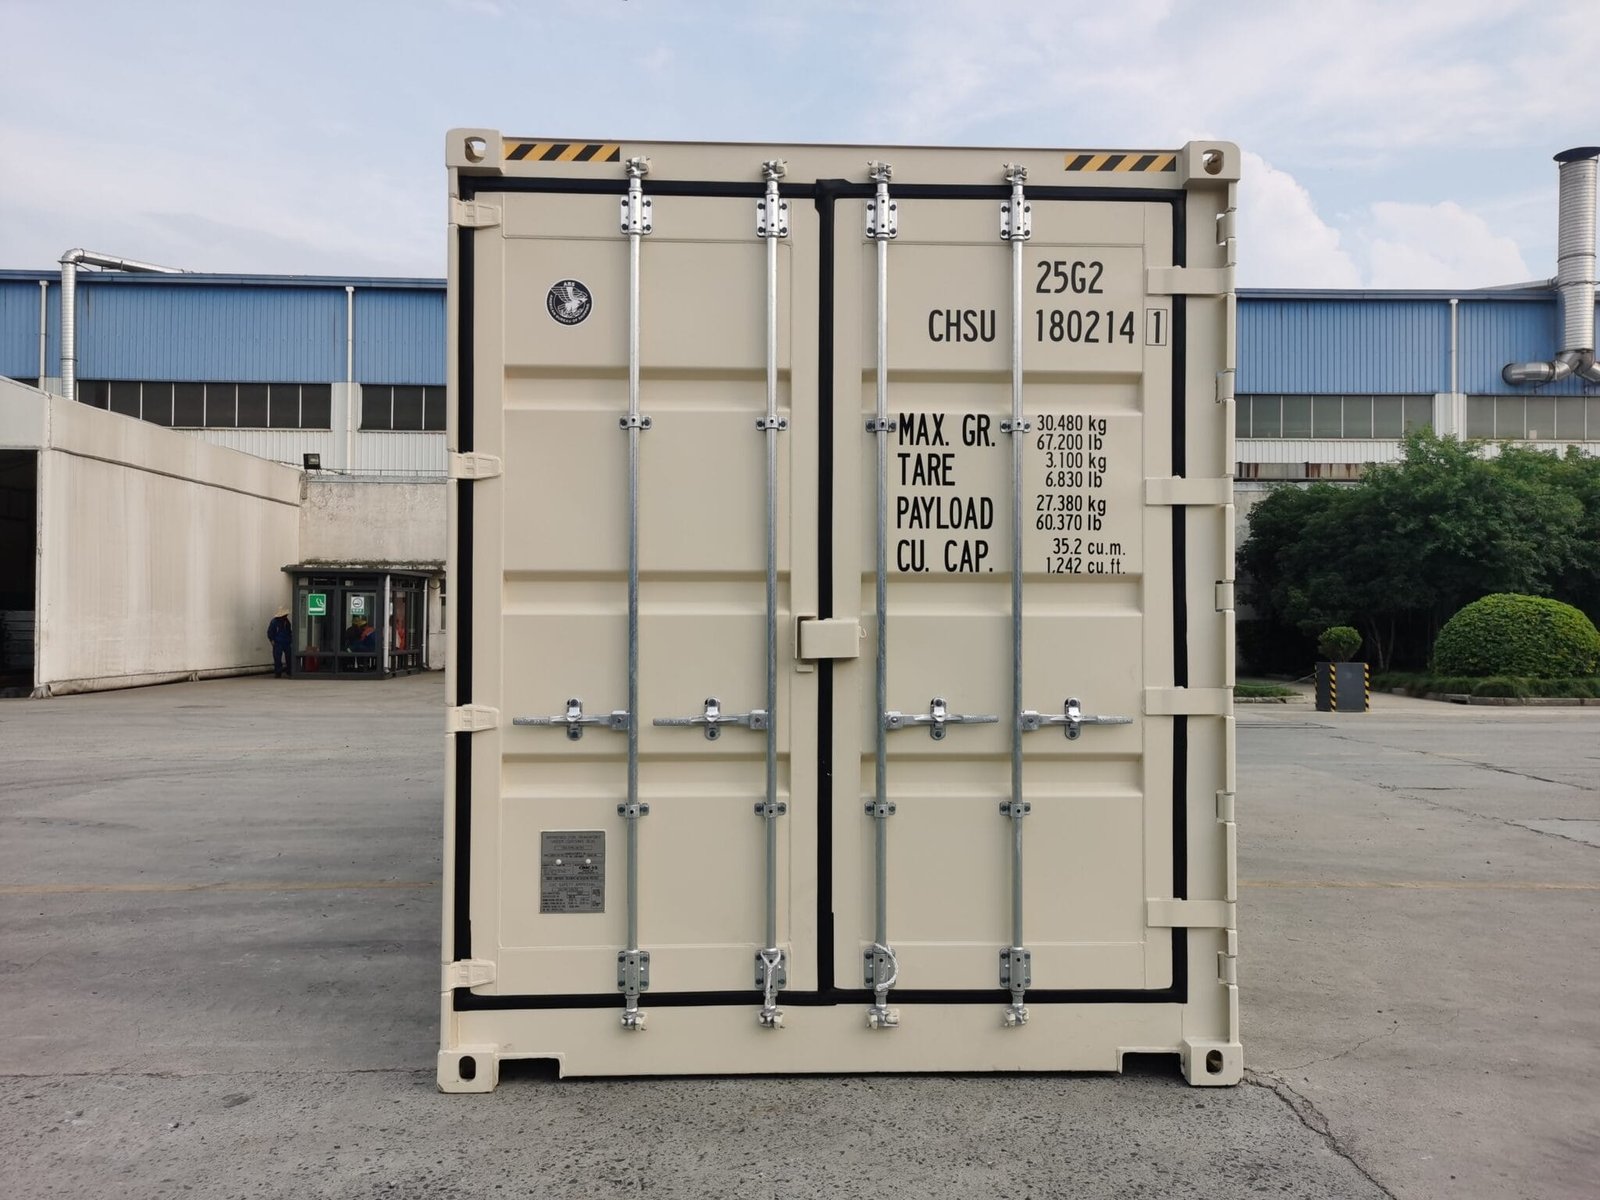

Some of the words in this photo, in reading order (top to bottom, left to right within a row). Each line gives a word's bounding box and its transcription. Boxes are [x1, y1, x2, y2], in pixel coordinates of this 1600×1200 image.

[1036, 261, 1104, 294] 25G2
[928, 309, 996, 343] CHSU
[1035, 309, 1135, 344] 180214
[1153, 311, 1161, 344] 1
[898, 413, 950, 447] MAX.
[961, 414, 996, 447] GR.
[1088, 415, 1107, 436] kg
[1088, 434, 1106, 451] lb
[897, 453, 956, 486] TARE
[1088, 452, 1107, 474] kg
[1088, 470, 1106, 488] lb
[896, 496, 994, 530] PAYLOAD
[1088, 495, 1107, 517] kg
[1087, 514, 1106, 531] lb
[896, 539, 929, 573] CU.
[944, 539, 993, 573] CAP.
[1052, 538, 1082, 555] 35.2
